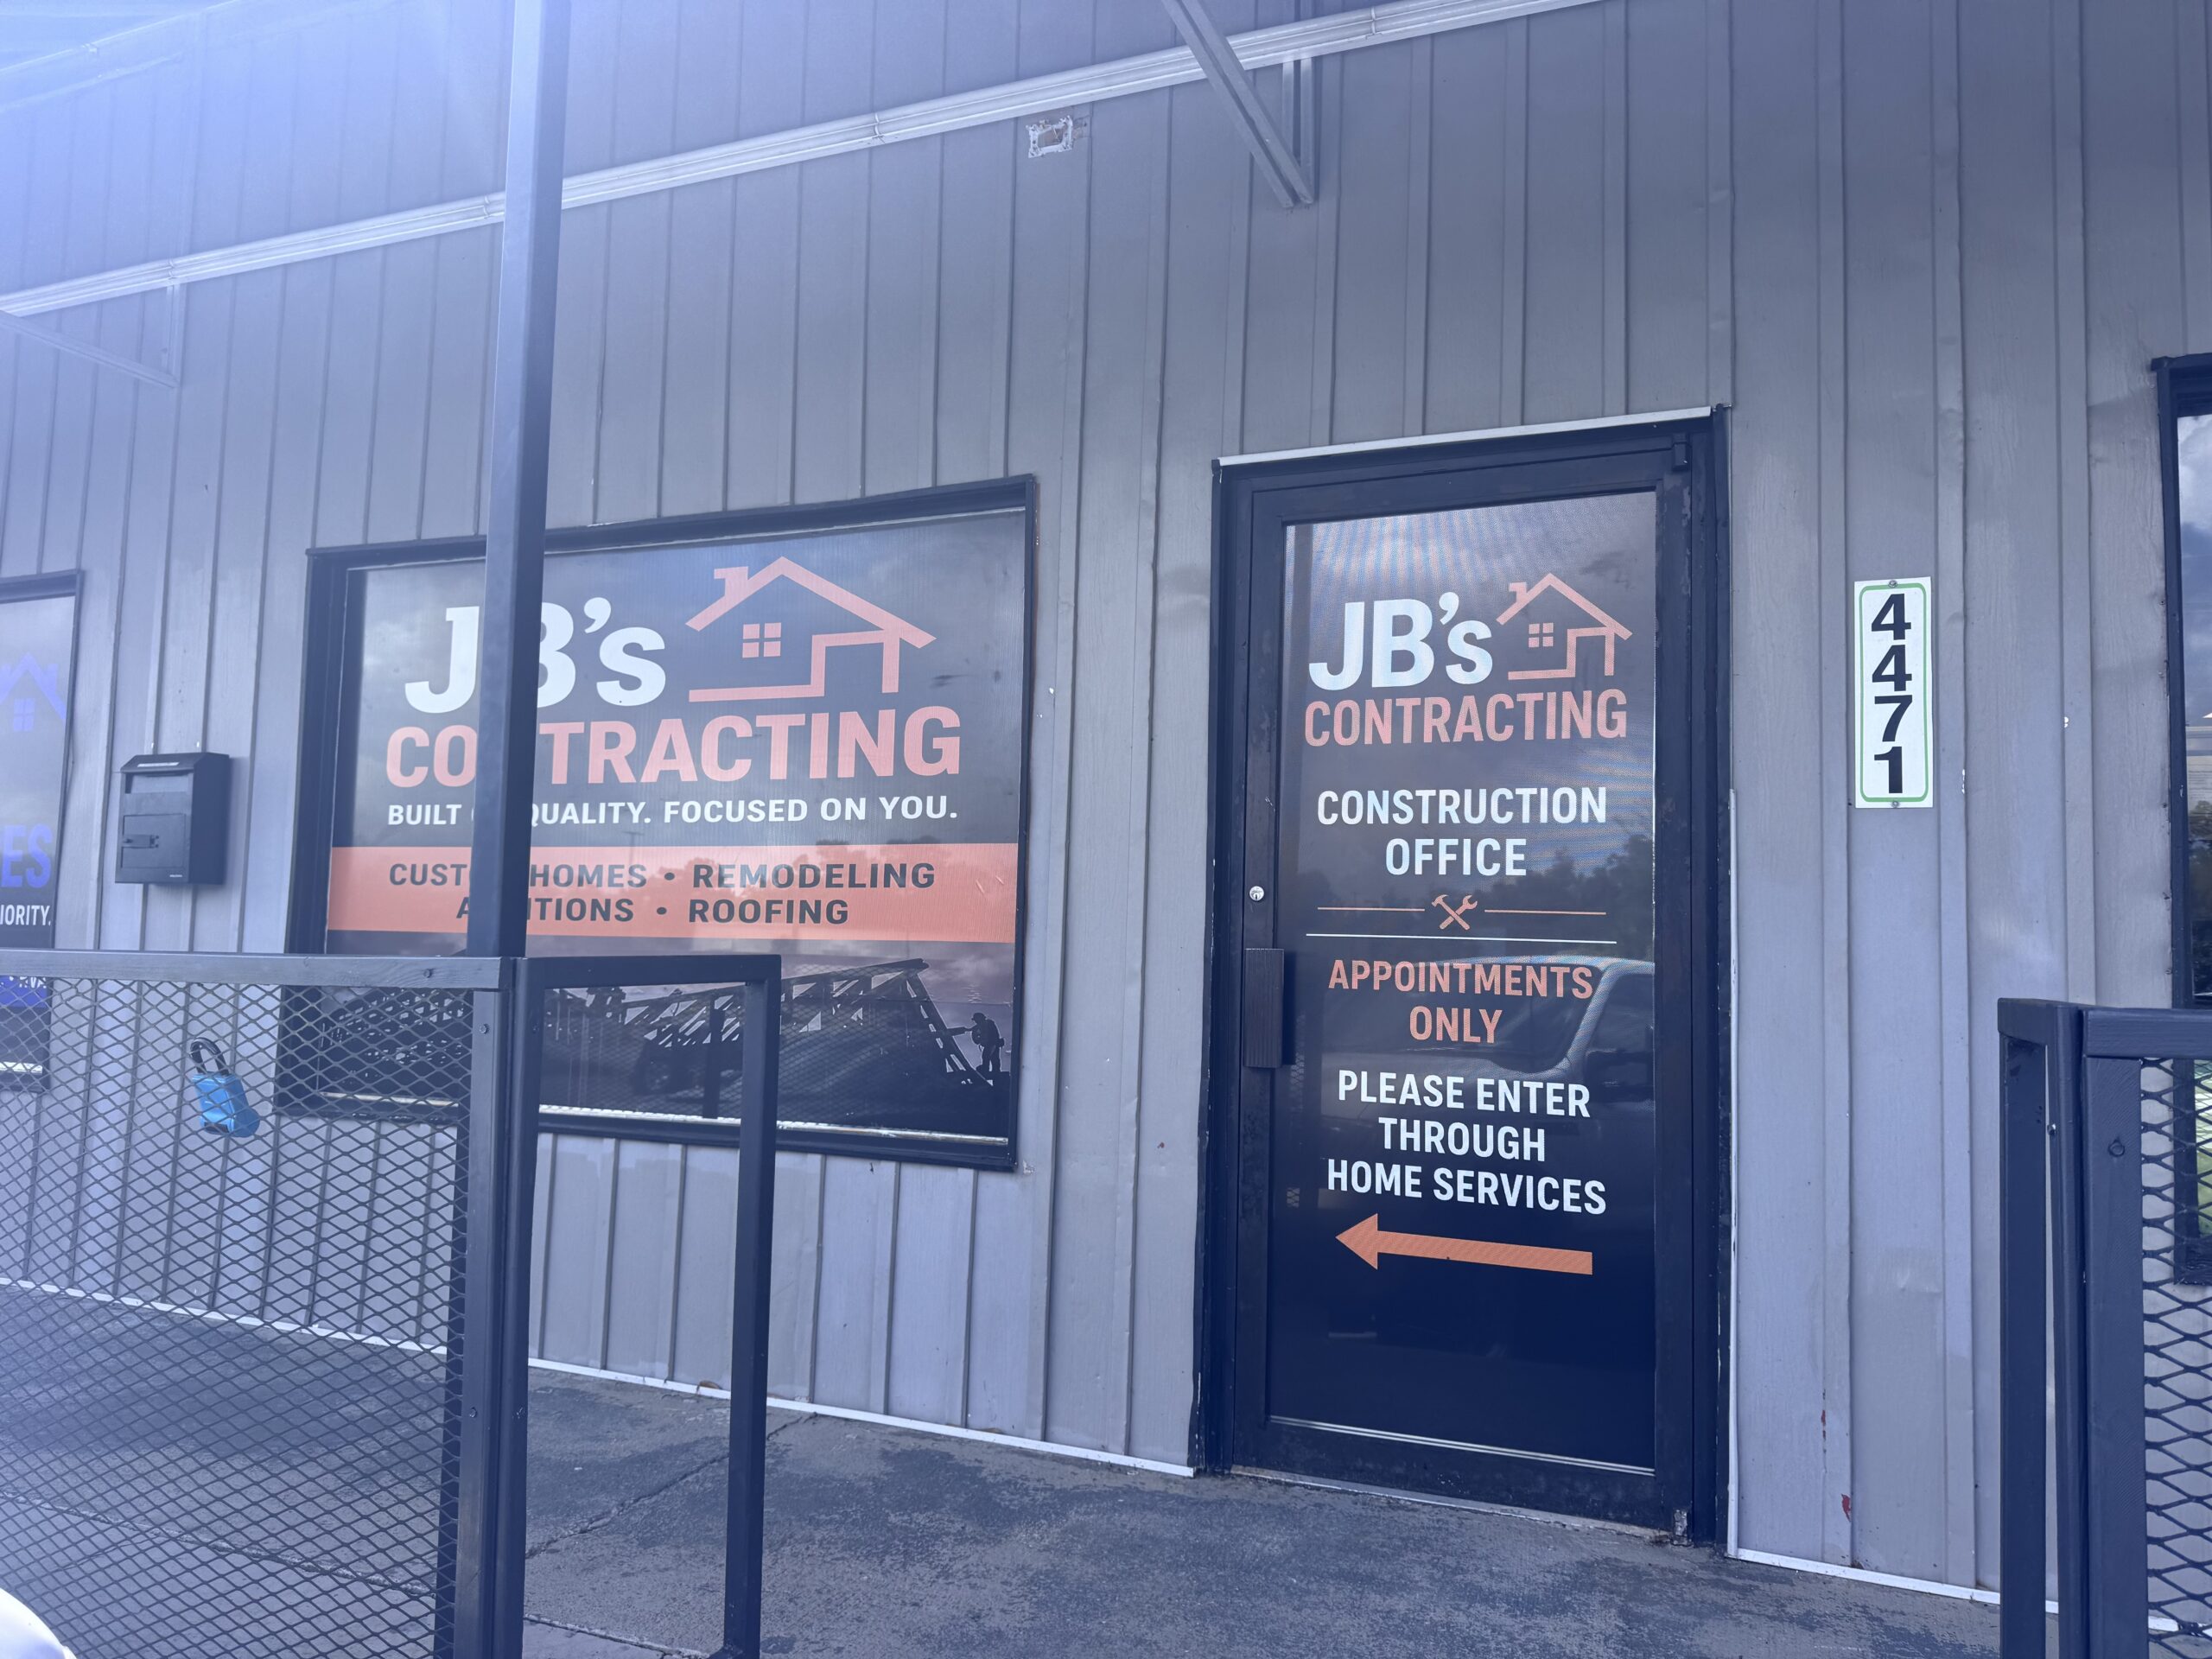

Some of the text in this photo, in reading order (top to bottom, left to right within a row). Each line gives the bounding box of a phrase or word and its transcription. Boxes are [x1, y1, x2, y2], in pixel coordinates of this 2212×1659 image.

[1309, 591, 1494, 691] JB's
[1871, 593, 1913, 794] 4471
[1305, 689, 1627, 747] CONTRACTING
[386, 705, 961, 788] COTRACTING
[388, 804, 462, 825] BUILT
[664, 798, 808, 823] FOCUSED
[820, 797, 867, 822] ON
[879, 795, 957, 820] YOU.
[1318, 786, 1607, 826] CONSTRUCTION
[530, 863, 647, 888] HOMES
[692, 862, 936, 889] REMODELING
[1386, 837, 1527, 876] OFFICE
[689, 898, 849, 925] ROOFING
[1328, 958, 1594, 1000] APPOINTMENTS
[1409, 1005, 1503, 1044] ONLY
[1338, 1070, 1591, 1117] PLEASE ENTER
[1378, 1116, 1546, 1162] THROUGH
[1327, 1158, 1607, 1215] HOME SERVICES
